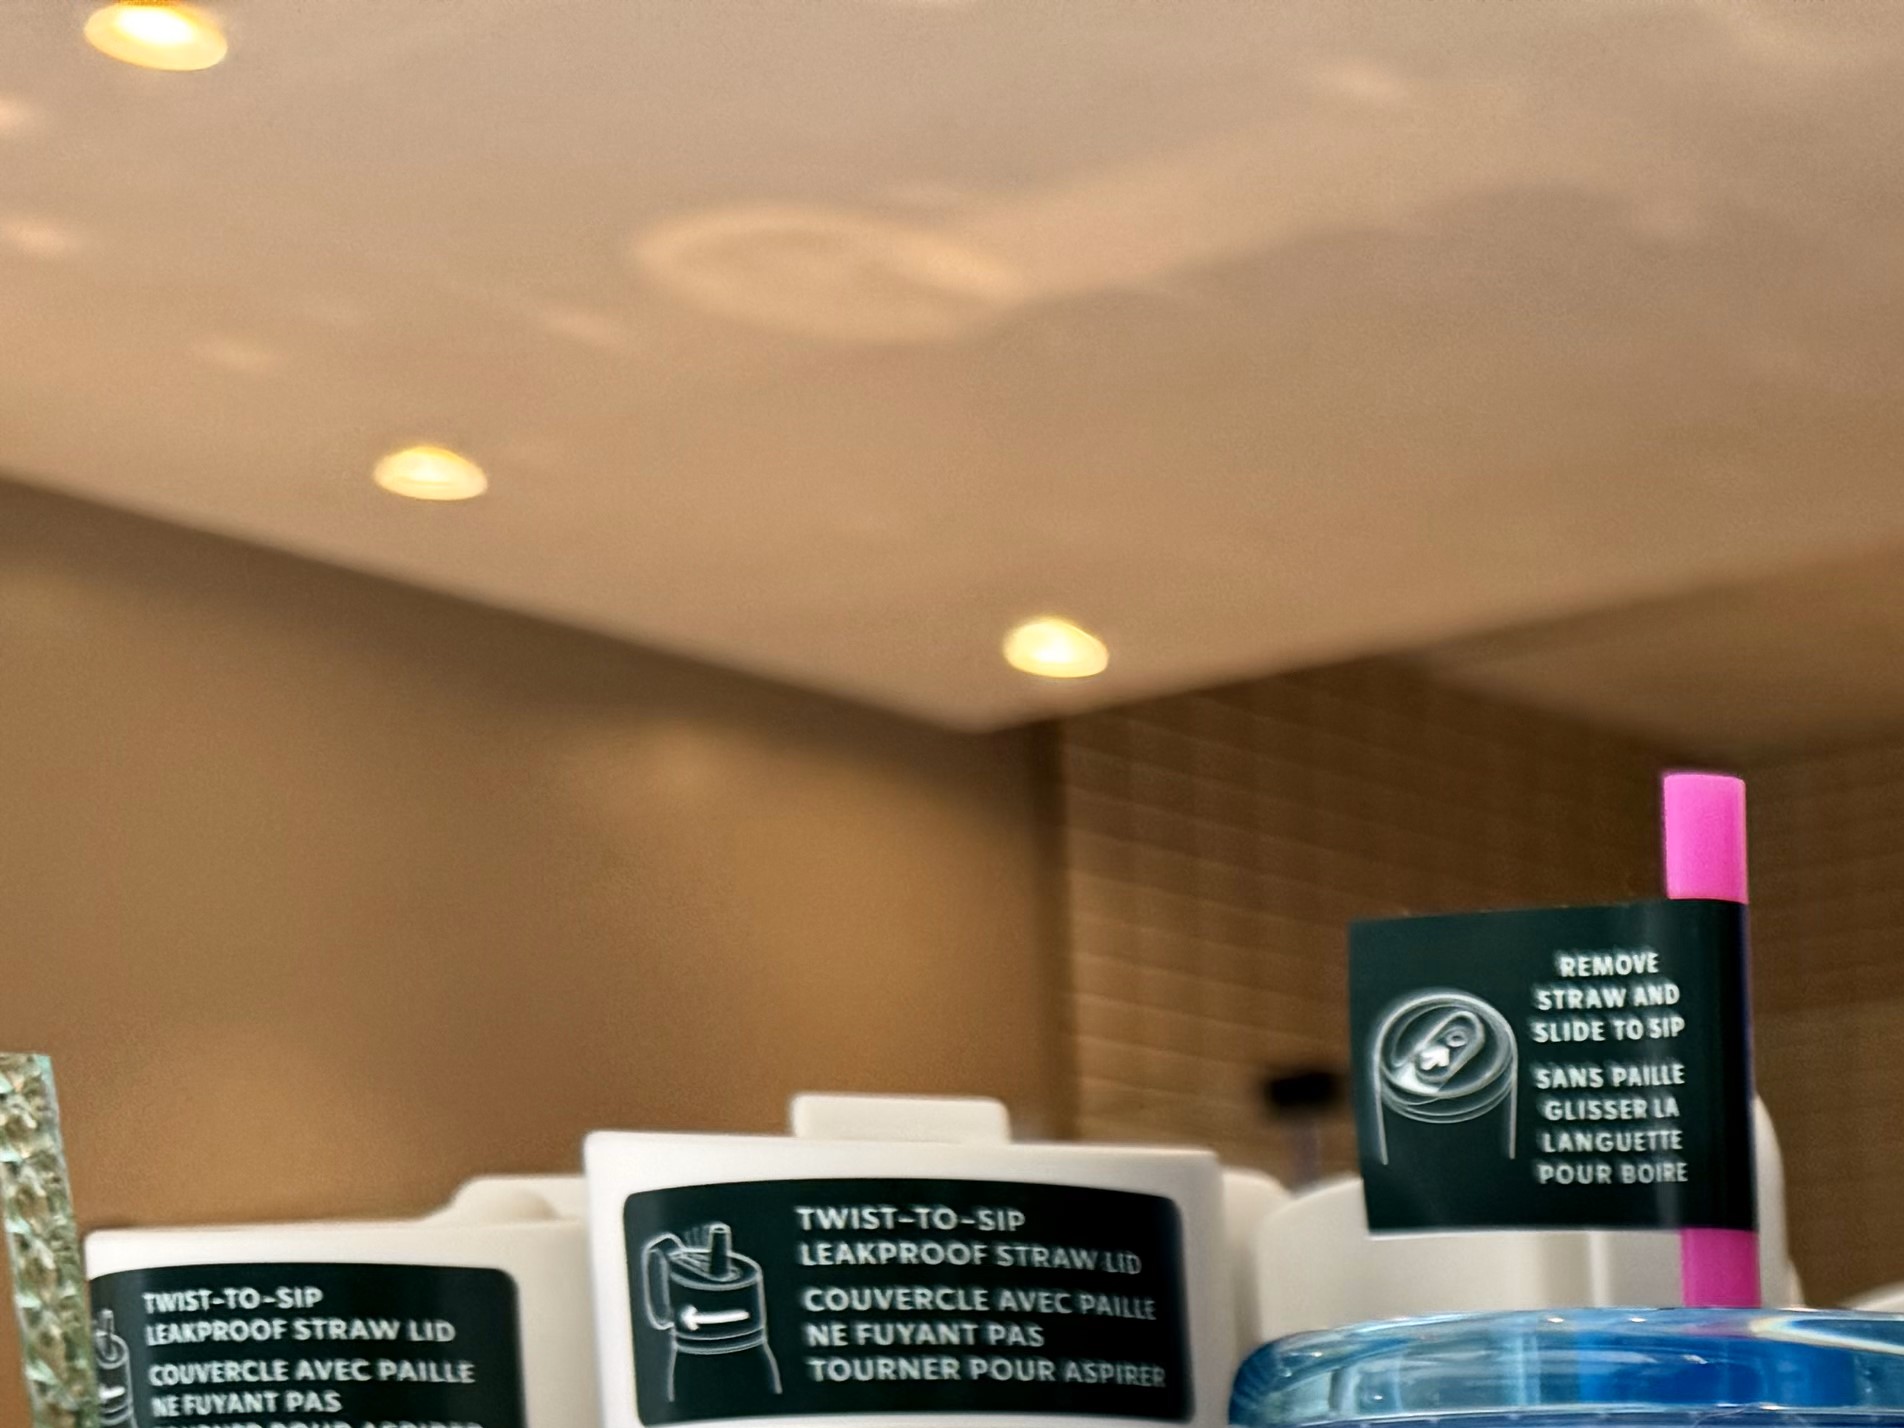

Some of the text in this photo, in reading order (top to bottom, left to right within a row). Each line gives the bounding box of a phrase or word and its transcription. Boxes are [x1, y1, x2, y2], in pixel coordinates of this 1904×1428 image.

[1558, 952, 1659, 977] REMOVE
[1536, 983, 1680, 1011] STRAW AND
[1531, 1016, 1685, 1043] SLIDE TO SIP
[1534, 1064, 1685, 1090] SANS PAILLE
[1544, 1097, 1680, 1120] GLISSER LA
[1542, 1129, 1683, 1153] LANGUETTE
[1536, 1161, 1688, 1185] POUR BOIRE
[795, 1205, 1025, 1231] TWIST-TO-SIP
[799, 1241, 1142, 1274] LEAKPROOF STRAW LID
[143, 1286, 323, 1314] TWIST-TO-SIP
[802, 1286, 1156, 1320] COUVERCLE AVEC PAILLE
[144, 1317, 456, 1346] LEAKPROOF STRAW LID
[805, 1321, 1045, 1347] NE FUYANT PAS
[148, 1358, 476, 1386] COUVERCLE AVEC PAILLE
[806, 1357, 1166, 1387] TOURNER POUR ASPIRER
[152, 1390, 343, 1417] NE FUYANT PAS
